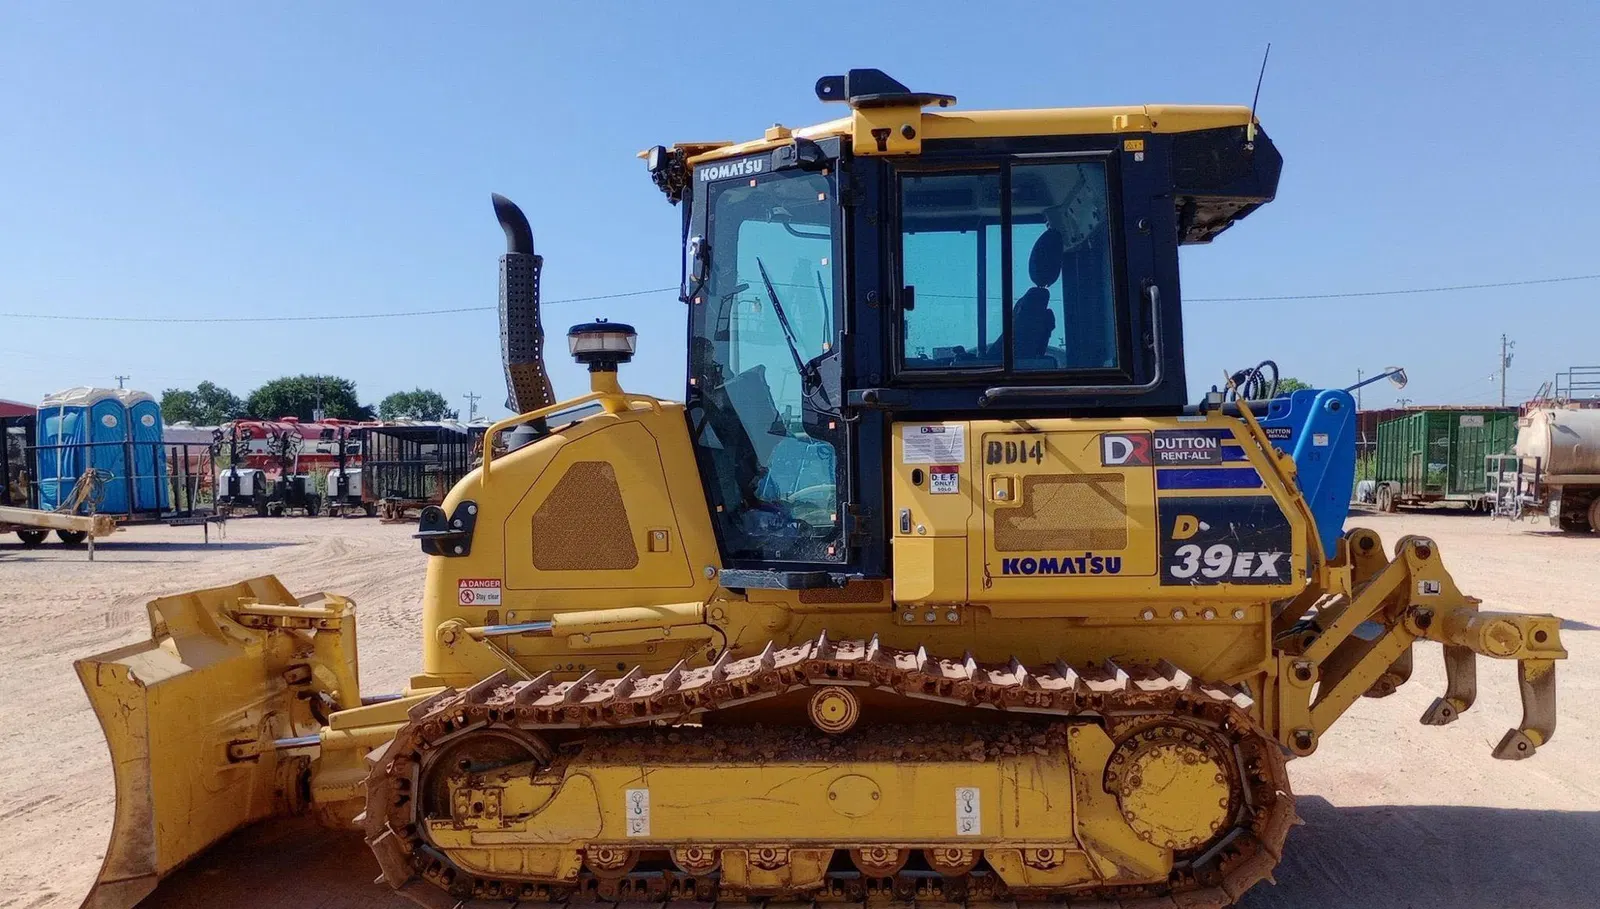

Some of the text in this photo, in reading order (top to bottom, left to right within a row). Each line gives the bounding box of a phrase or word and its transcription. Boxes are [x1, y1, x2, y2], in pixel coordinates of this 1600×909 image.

[700, 159, 763, 181] KOMATSU
[1104, 436, 1150, 465] DR
[1155, 437, 1217, 449] DUTTON
[1161, 452, 1211, 460] RENT-ALL
[1171, 514, 1199, 540] D
[1002, 552, 1121, 575] KOMATSU
